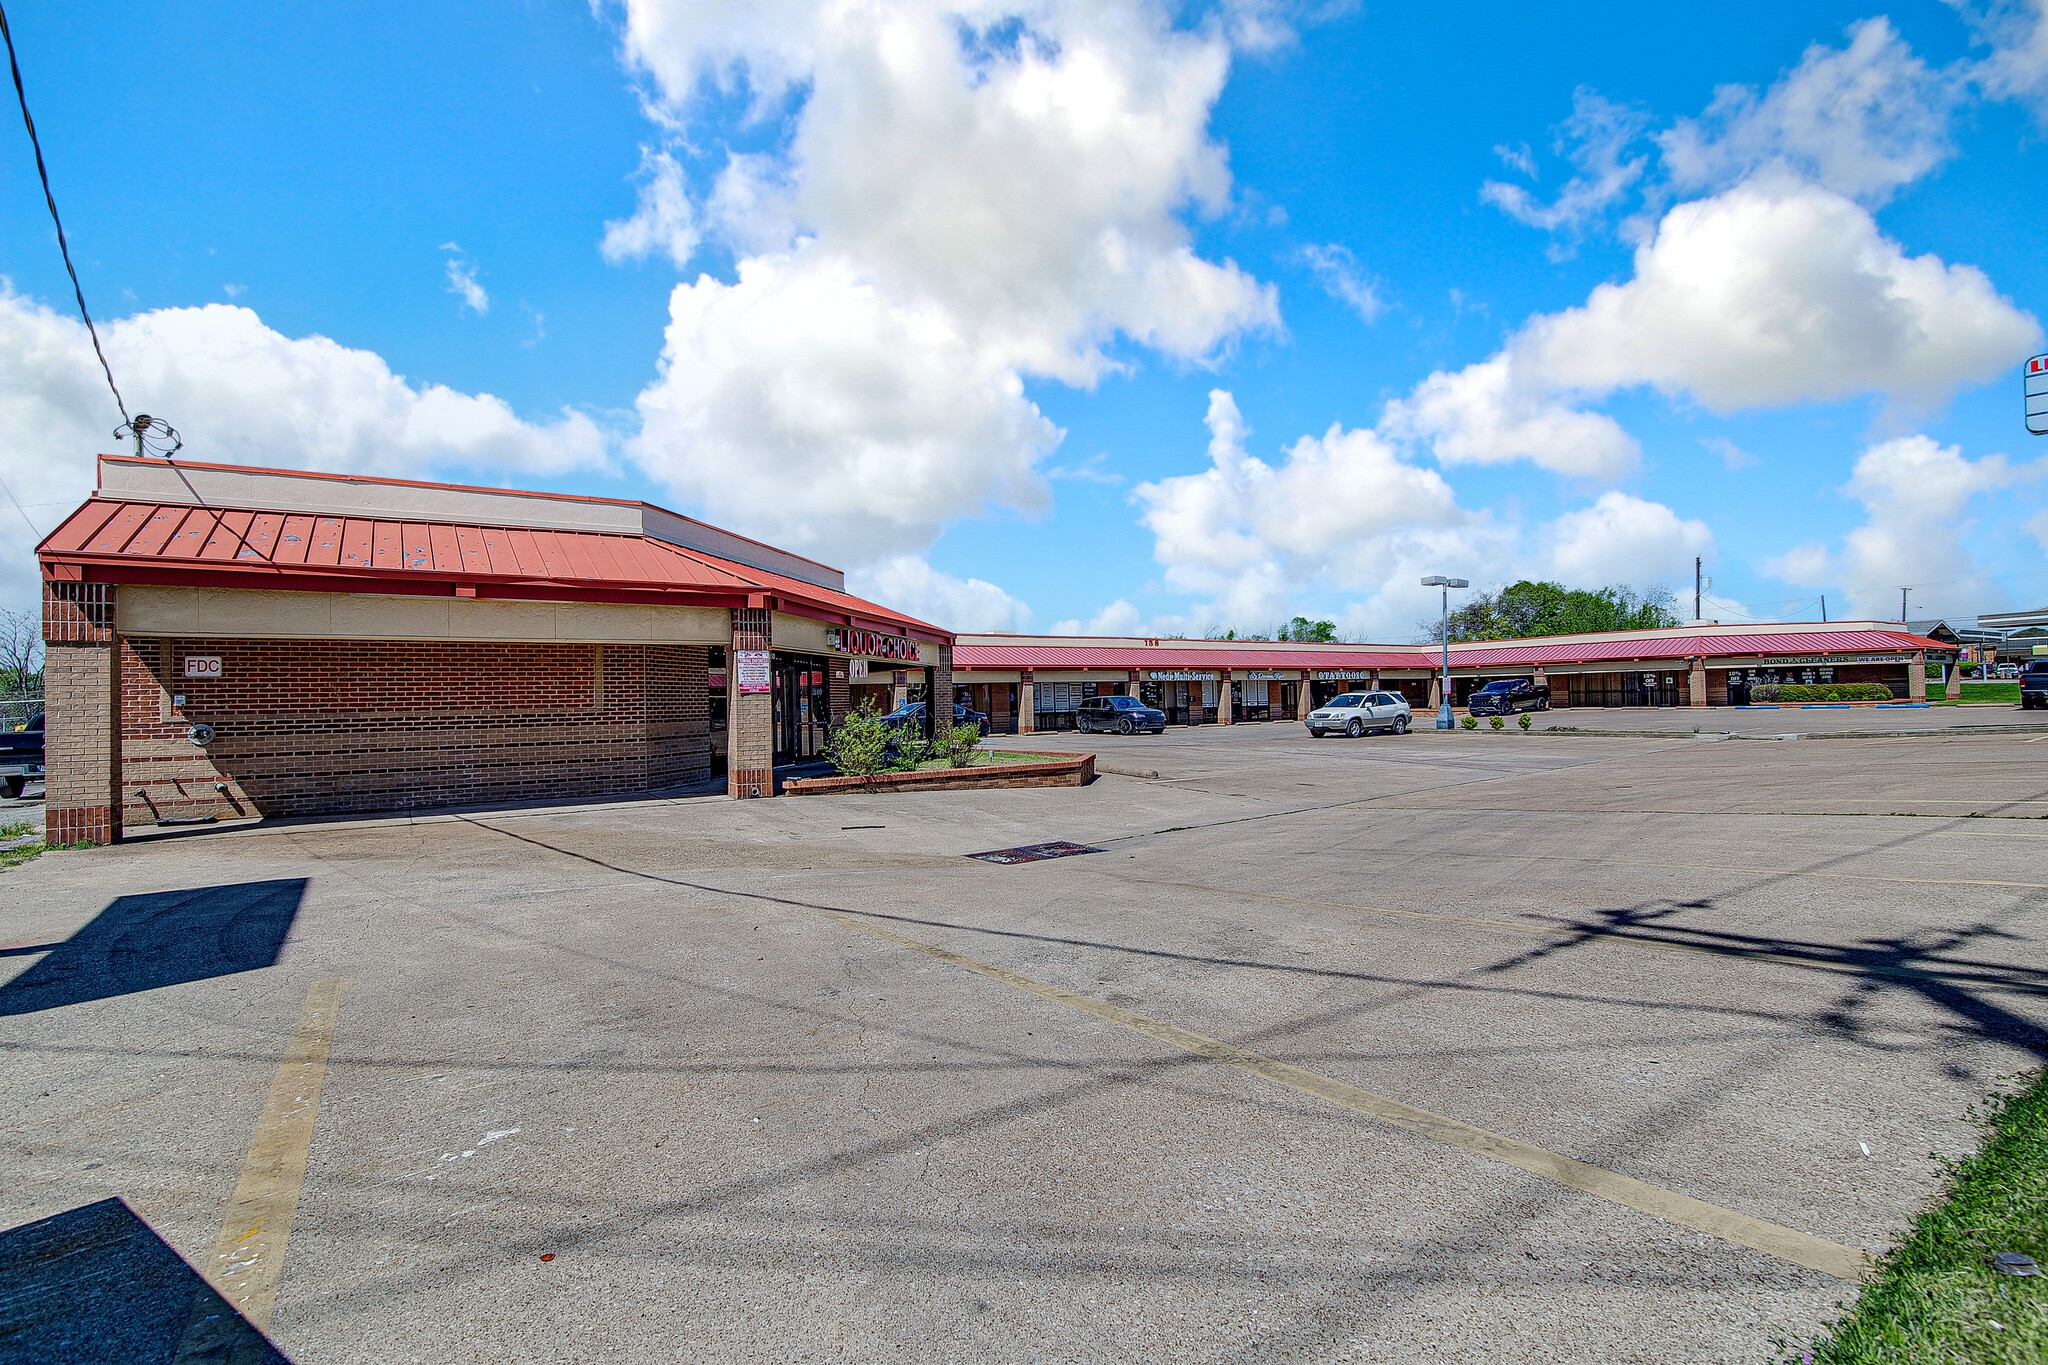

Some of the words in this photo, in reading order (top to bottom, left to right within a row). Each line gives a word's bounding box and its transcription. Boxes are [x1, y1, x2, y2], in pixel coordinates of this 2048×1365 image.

[840, 628, 883, 656] LIQUOR
[887, 637, 920, 661] CHOICE
[188, 660, 219, 673] FDC
[1799, 656, 1849, 664] CLEANERS
[849, 659, 868, 678] OPEN
